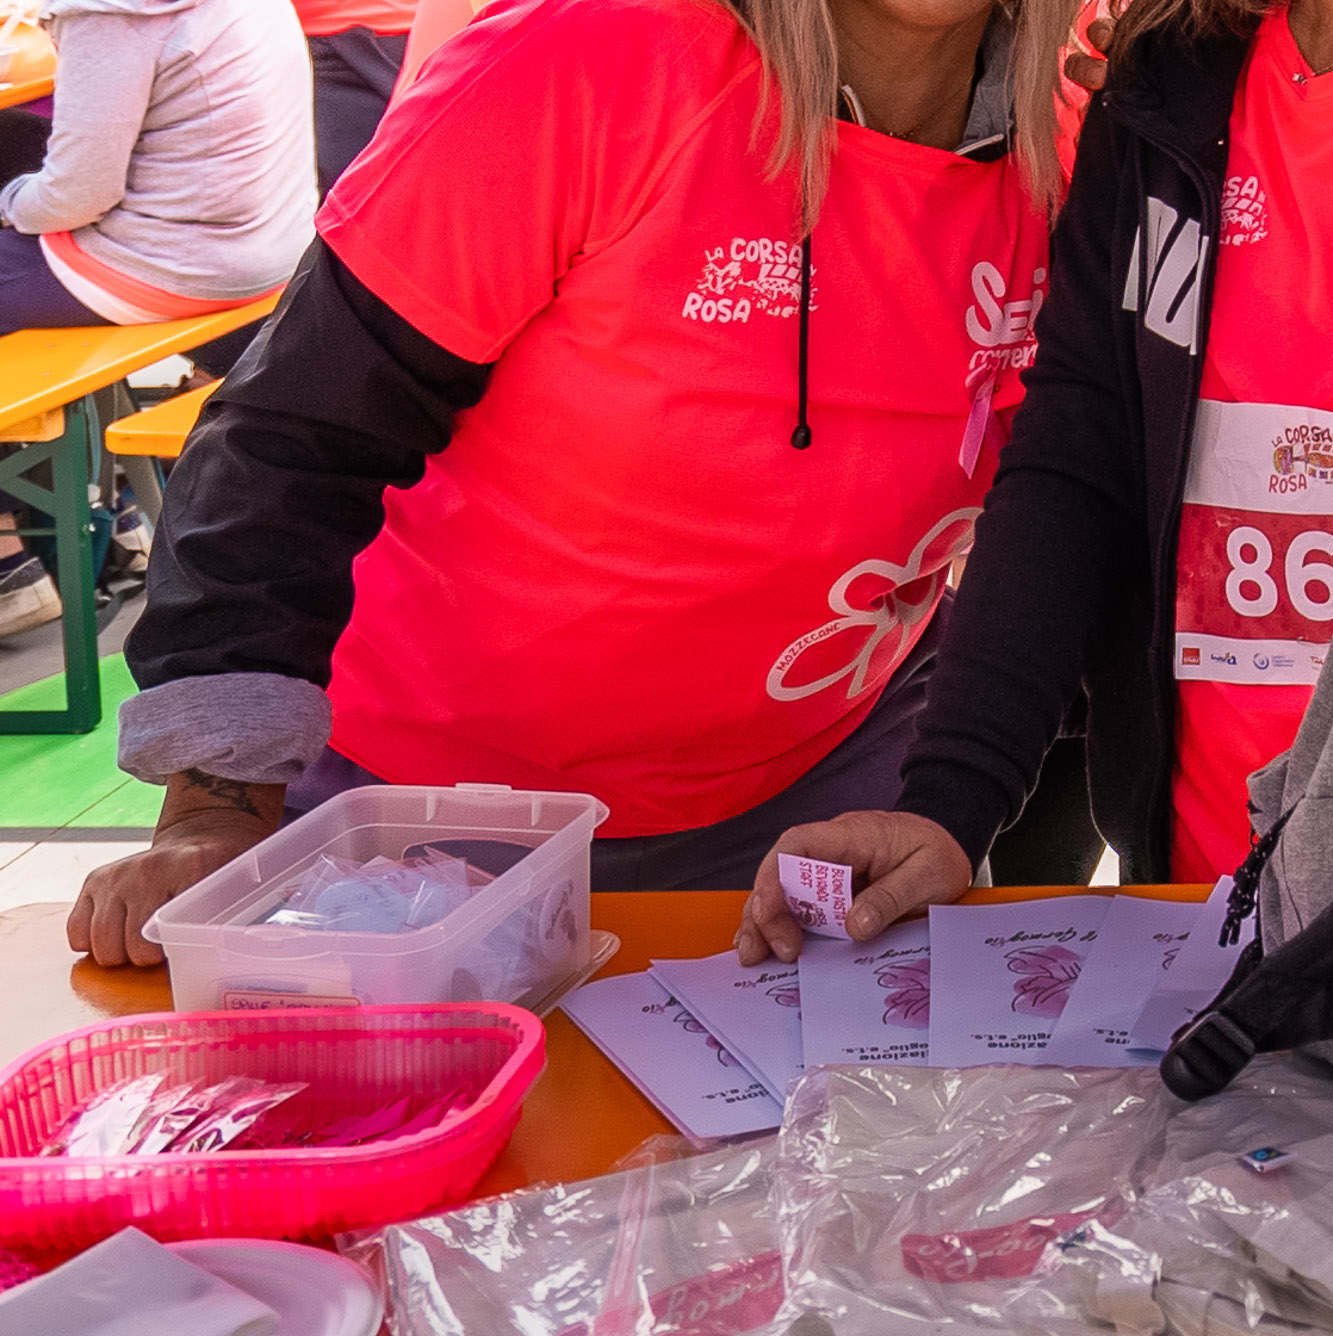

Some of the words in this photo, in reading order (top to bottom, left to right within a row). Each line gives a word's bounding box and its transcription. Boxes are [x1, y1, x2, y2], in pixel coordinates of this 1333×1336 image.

[730, 237, 804, 263] CORSA
[682, 291, 751, 324] ROSA
[1285, 424, 1332, 444] CORSA
[1268, 473, 1308, 494] ROSA
